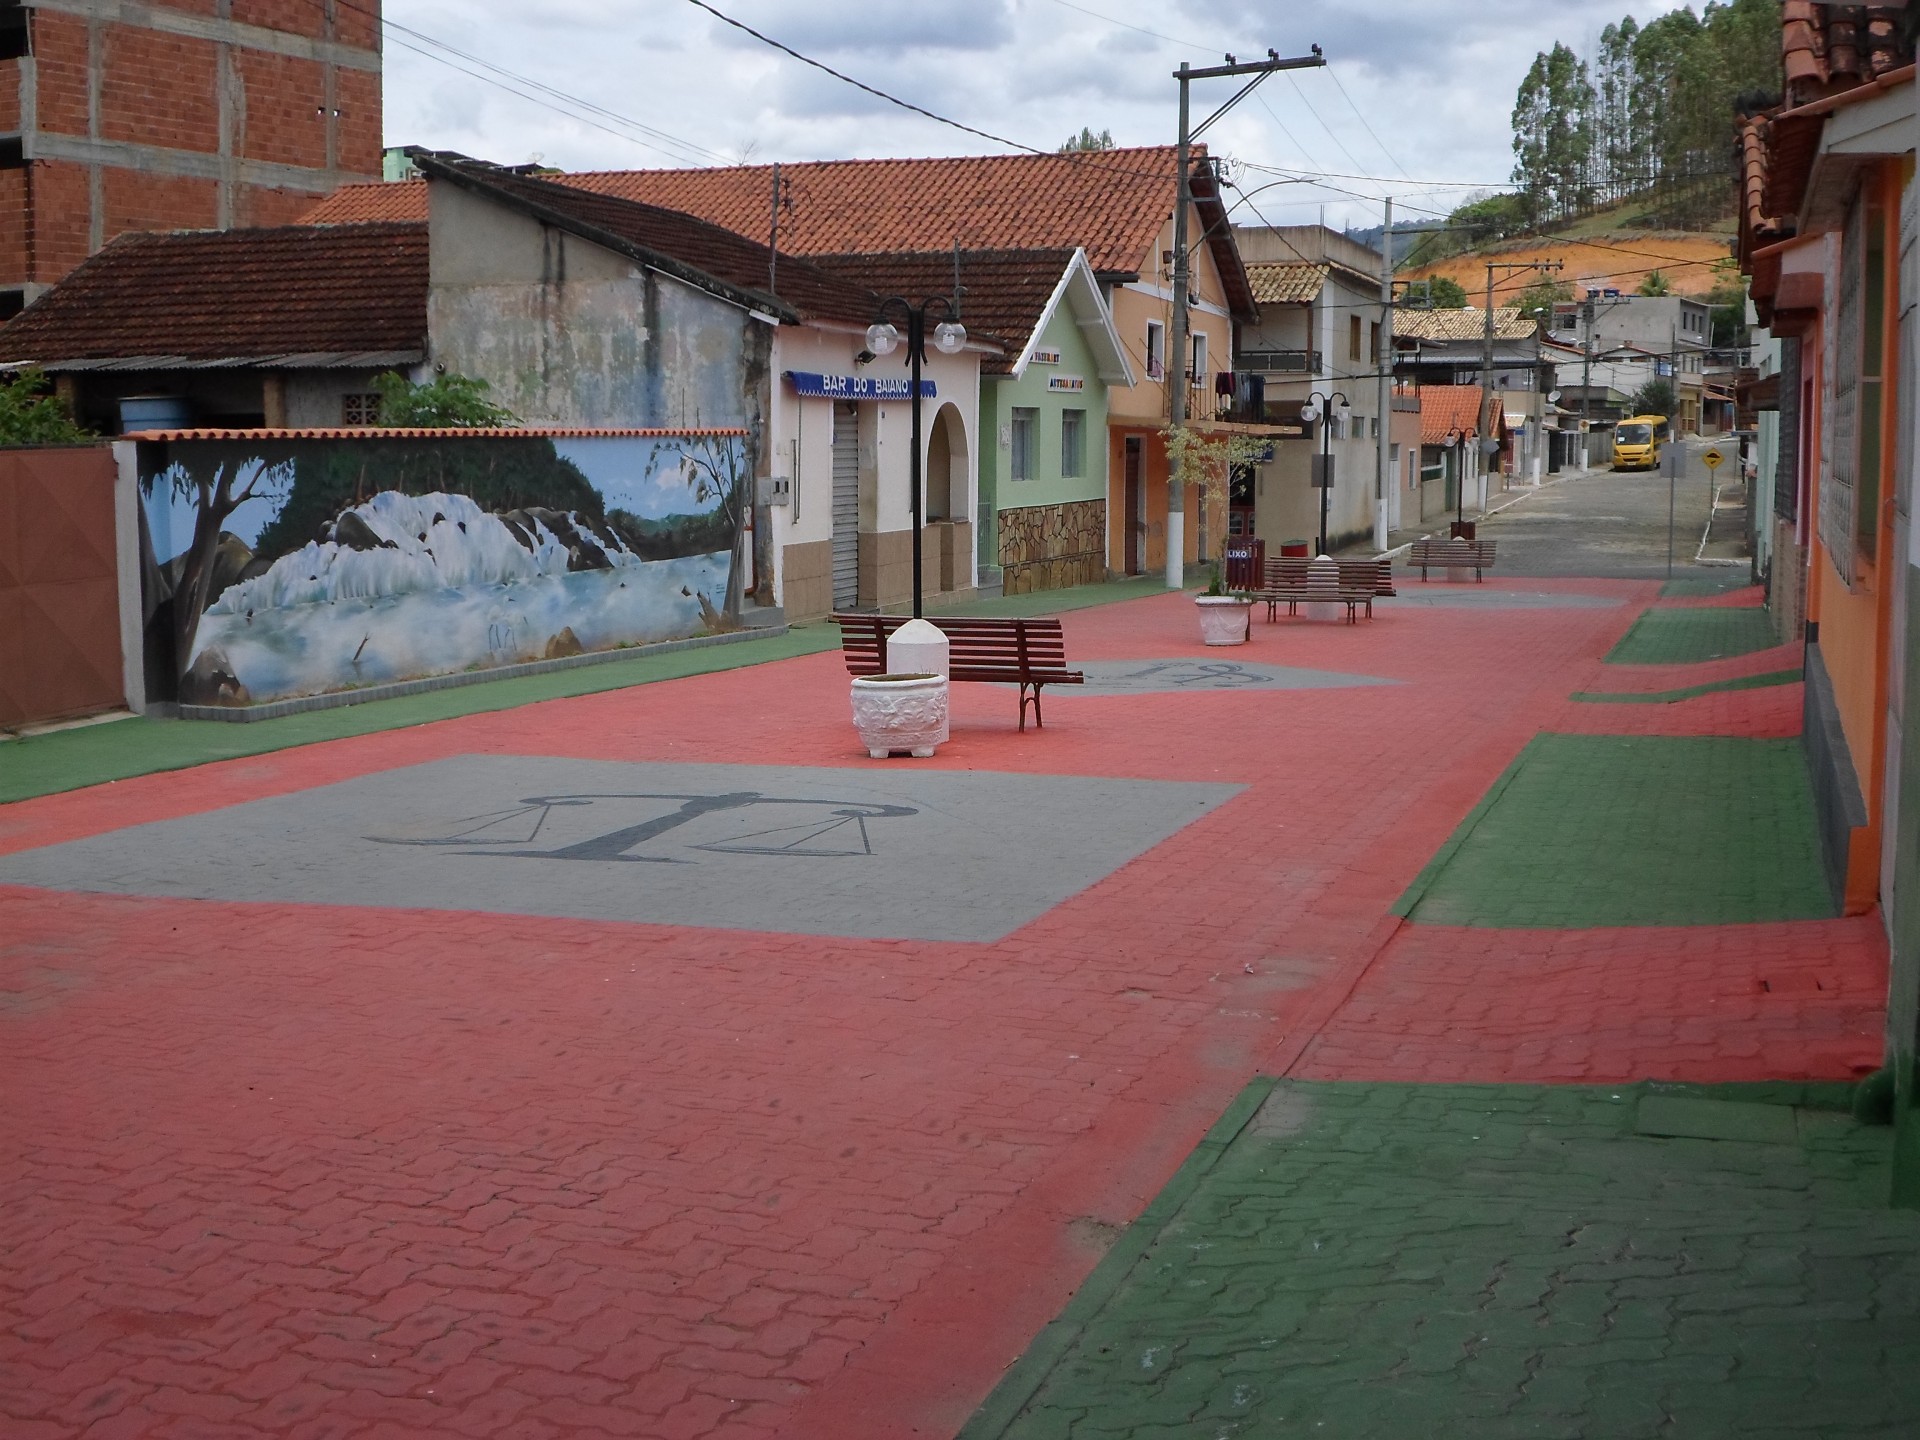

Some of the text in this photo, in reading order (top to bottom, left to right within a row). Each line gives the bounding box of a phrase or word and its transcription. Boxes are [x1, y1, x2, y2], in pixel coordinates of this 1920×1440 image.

[822, 374, 908, 394] BAR DO BAIANO
[1228, 550, 1247, 558] LIXO
